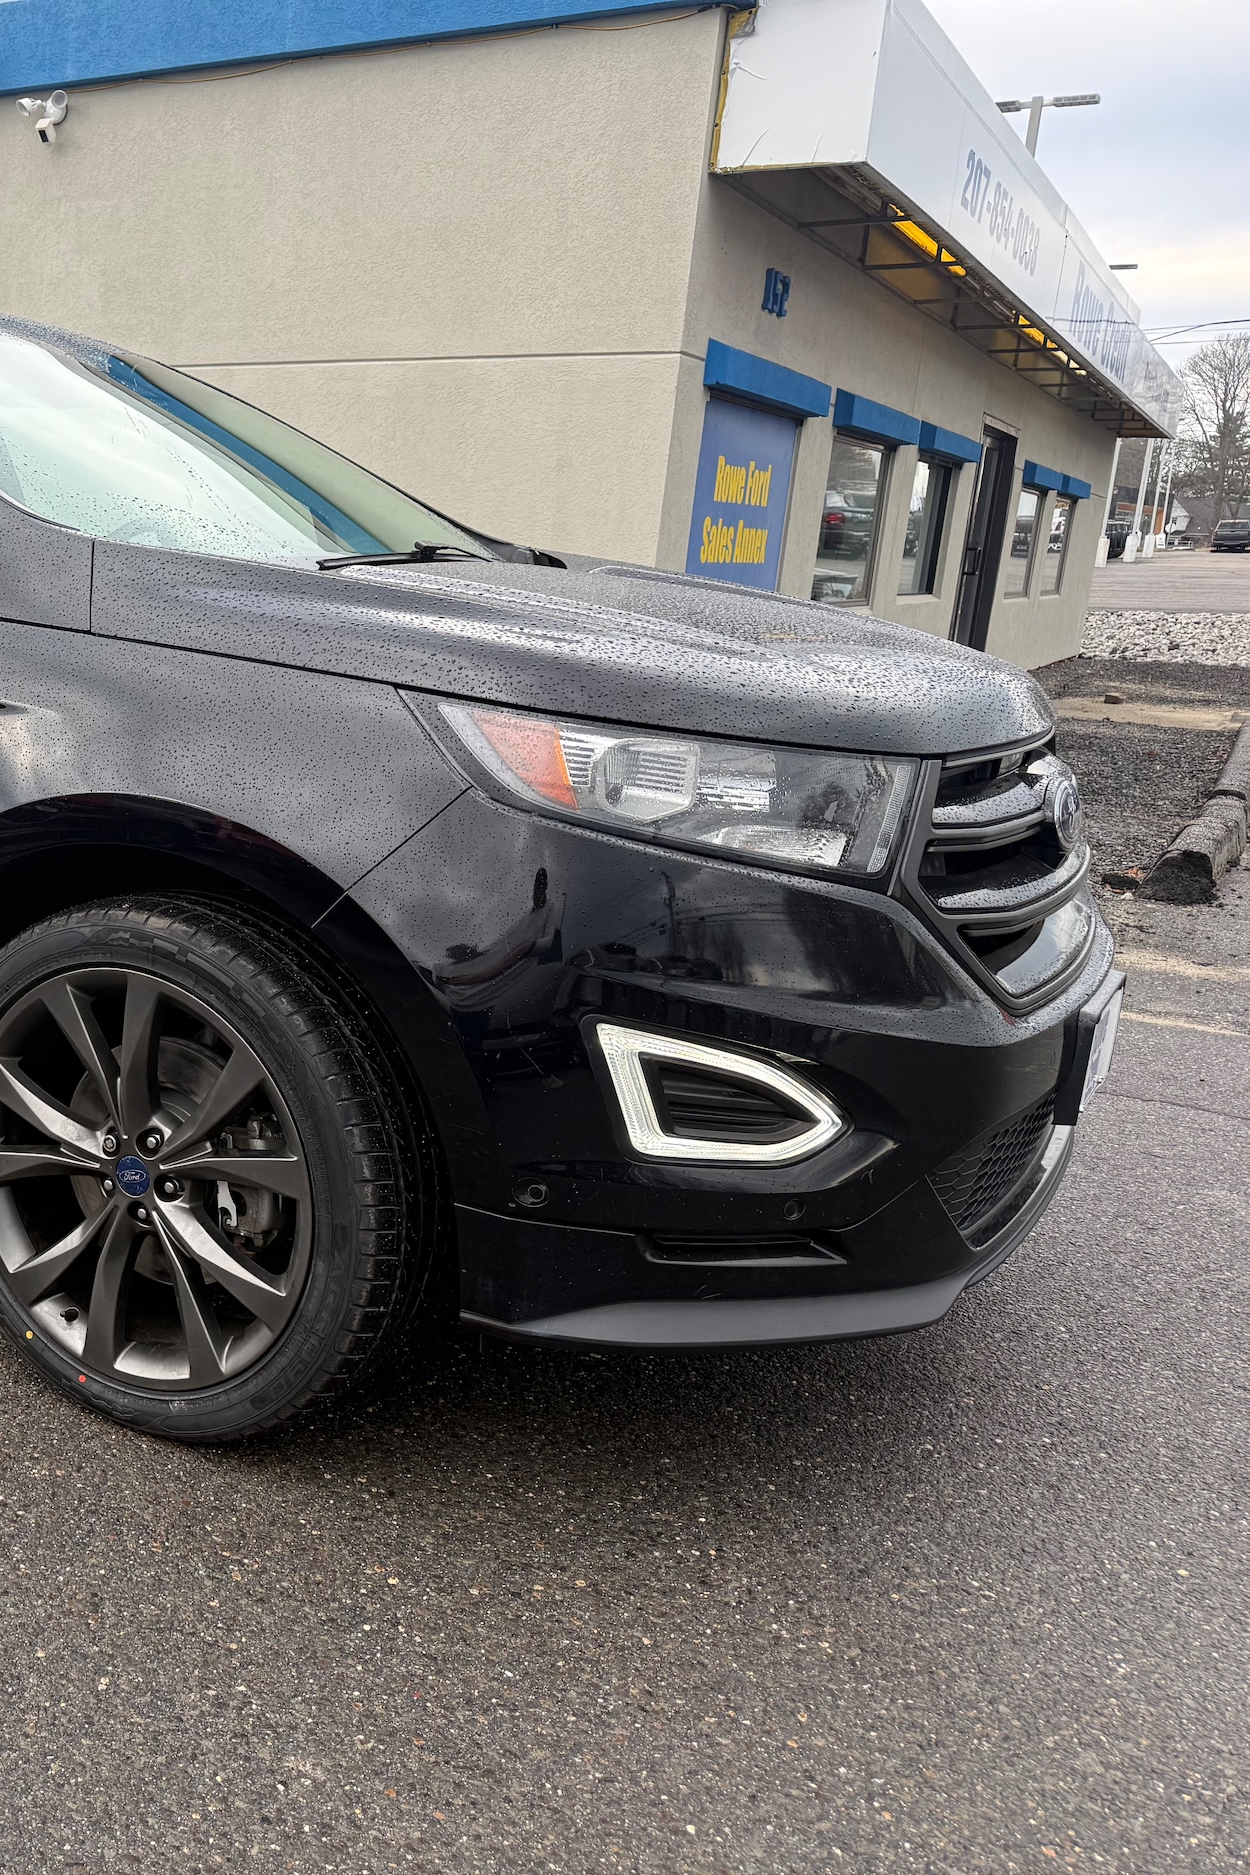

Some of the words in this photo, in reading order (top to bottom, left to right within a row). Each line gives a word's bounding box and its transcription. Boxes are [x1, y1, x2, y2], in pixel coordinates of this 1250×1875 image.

[960, 148, 1040, 277] 207-854-0038
[1069, 258, 1104, 357] Rowe
[1101, 301, 1131, 384] Credit
[713, 455, 747, 504] Rowe
[745, 461, 773, 507] Ford
[700, 516, 735, 564] Sales
[733, 519, 769, 564] Annex
[124, 1171, 141, 1180] Ford
